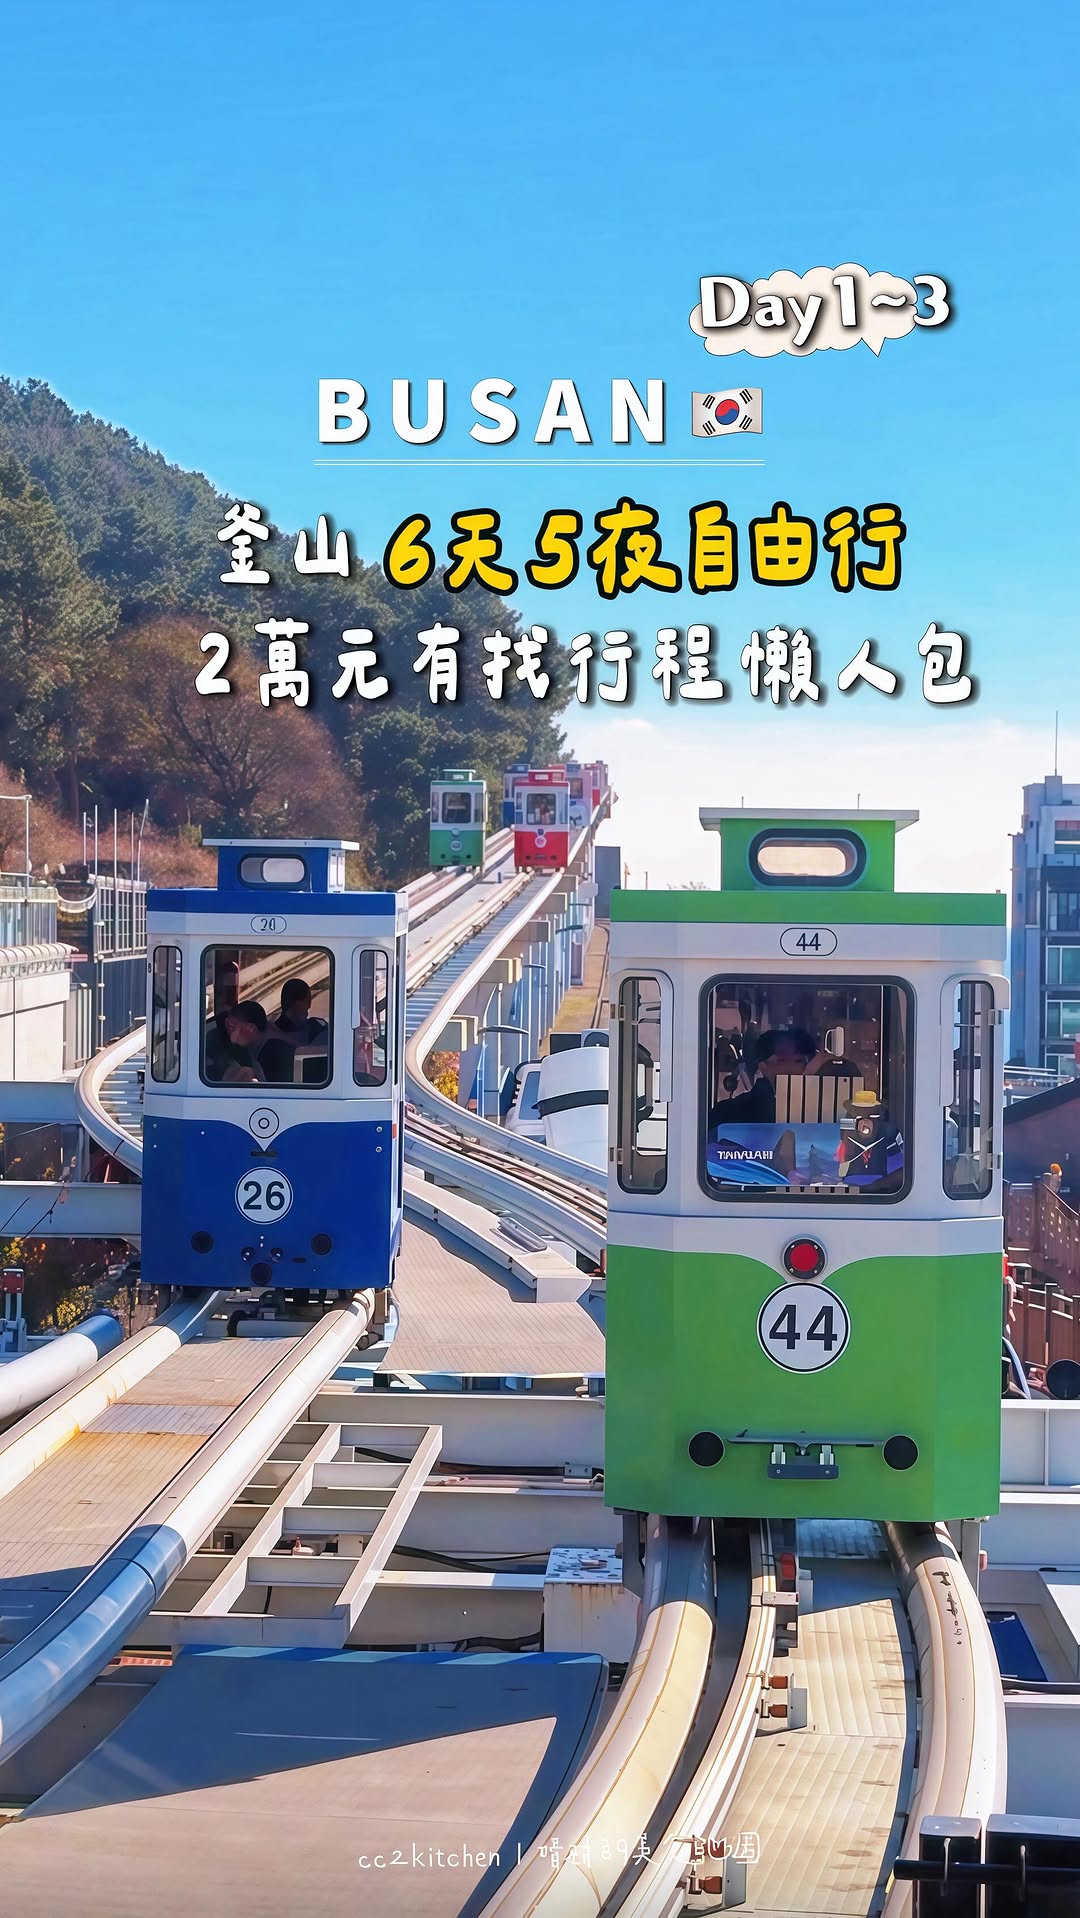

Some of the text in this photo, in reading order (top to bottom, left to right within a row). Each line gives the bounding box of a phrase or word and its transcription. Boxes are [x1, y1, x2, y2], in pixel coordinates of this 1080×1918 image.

[795, 932, 822, 952] 44
[243, 1180, 286, 1211] 26
[768, 1303, 839, 1352] 44
